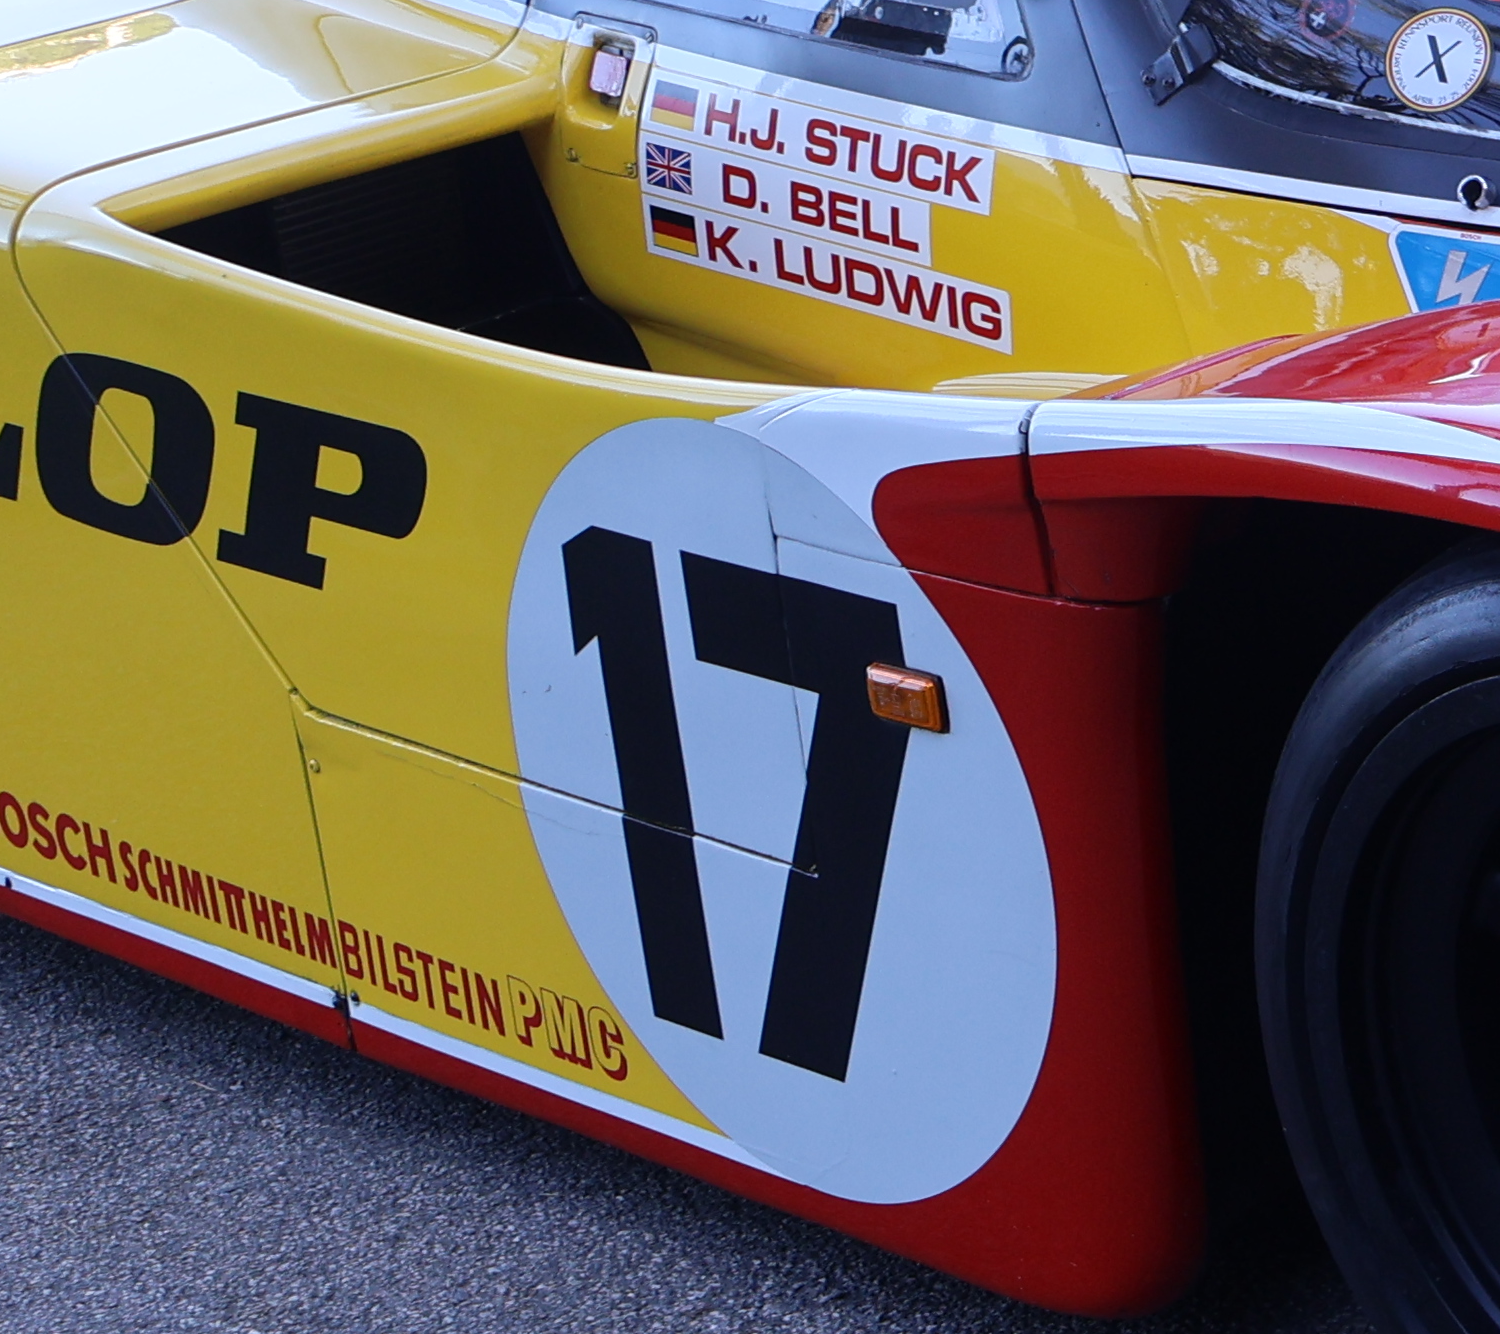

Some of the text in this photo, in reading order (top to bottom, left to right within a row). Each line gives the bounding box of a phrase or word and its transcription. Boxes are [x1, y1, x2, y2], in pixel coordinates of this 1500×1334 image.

[704, 92, 983, 204] H.J. STUCK
[722, 162, 919, 253] D. BELL
[1460, 233, 1482, 241] BOSCH
[705, 219, 1002, 341] K. LUDWIG
[561, 524, 912, 1083] 17
[118, 840, 339, 970] SCHMITTHELM
[338, 919, 507, 1037] BILSTEIN
[506, 974, 628, 1081] PMC
